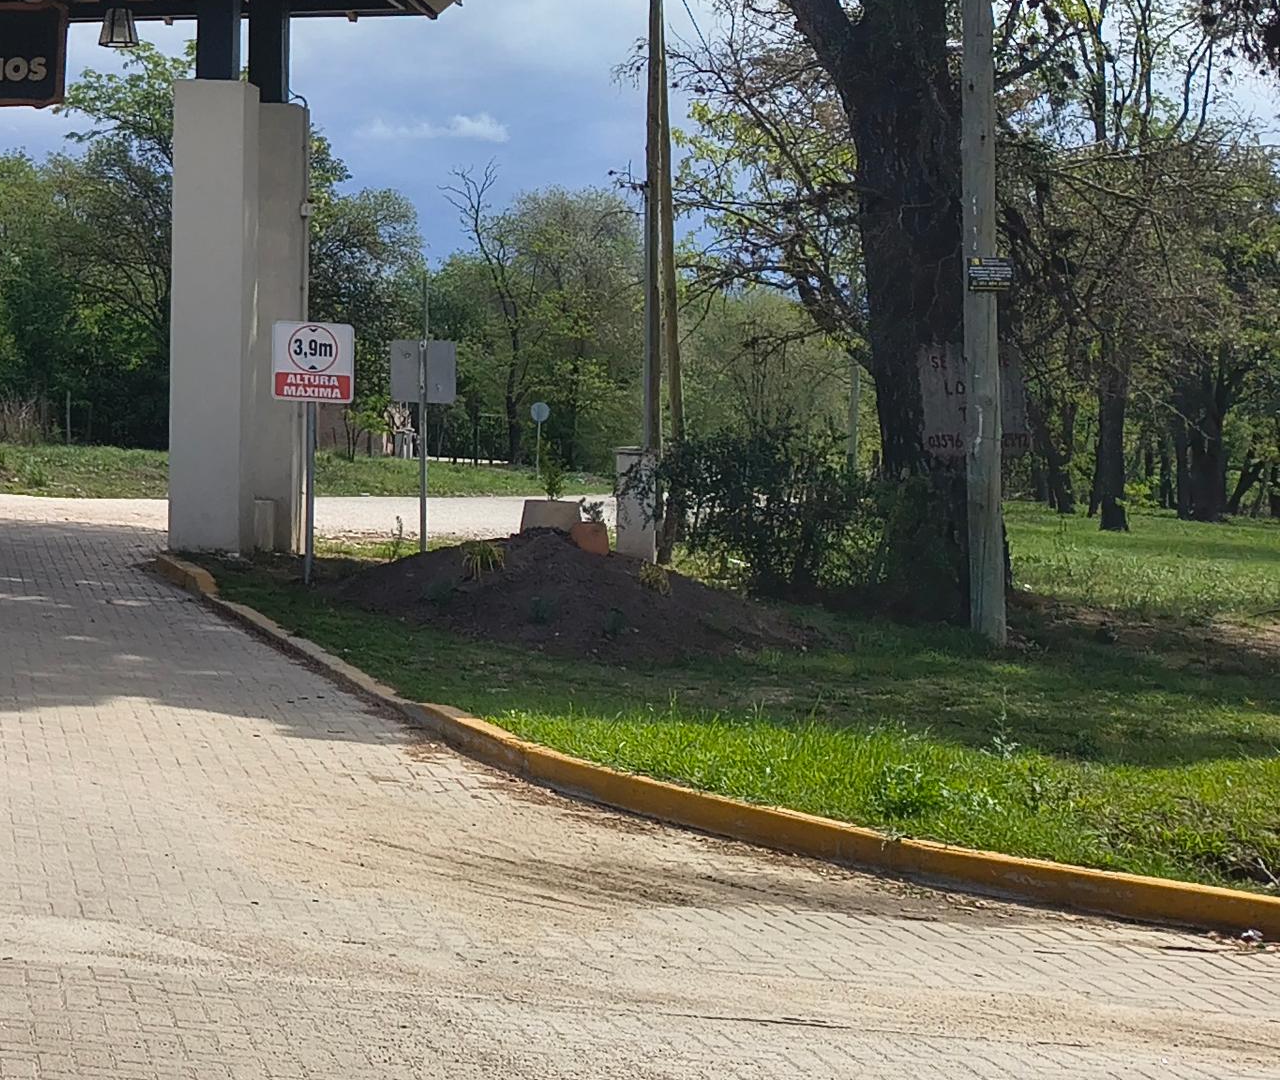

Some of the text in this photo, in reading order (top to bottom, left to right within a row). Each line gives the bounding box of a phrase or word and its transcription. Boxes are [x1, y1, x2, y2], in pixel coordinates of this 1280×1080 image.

[293, 338, 333, 358] 3,9m
[286, 373, 339, 387] ALTURA
[283, 385, 342, 399] MÁXIMA
